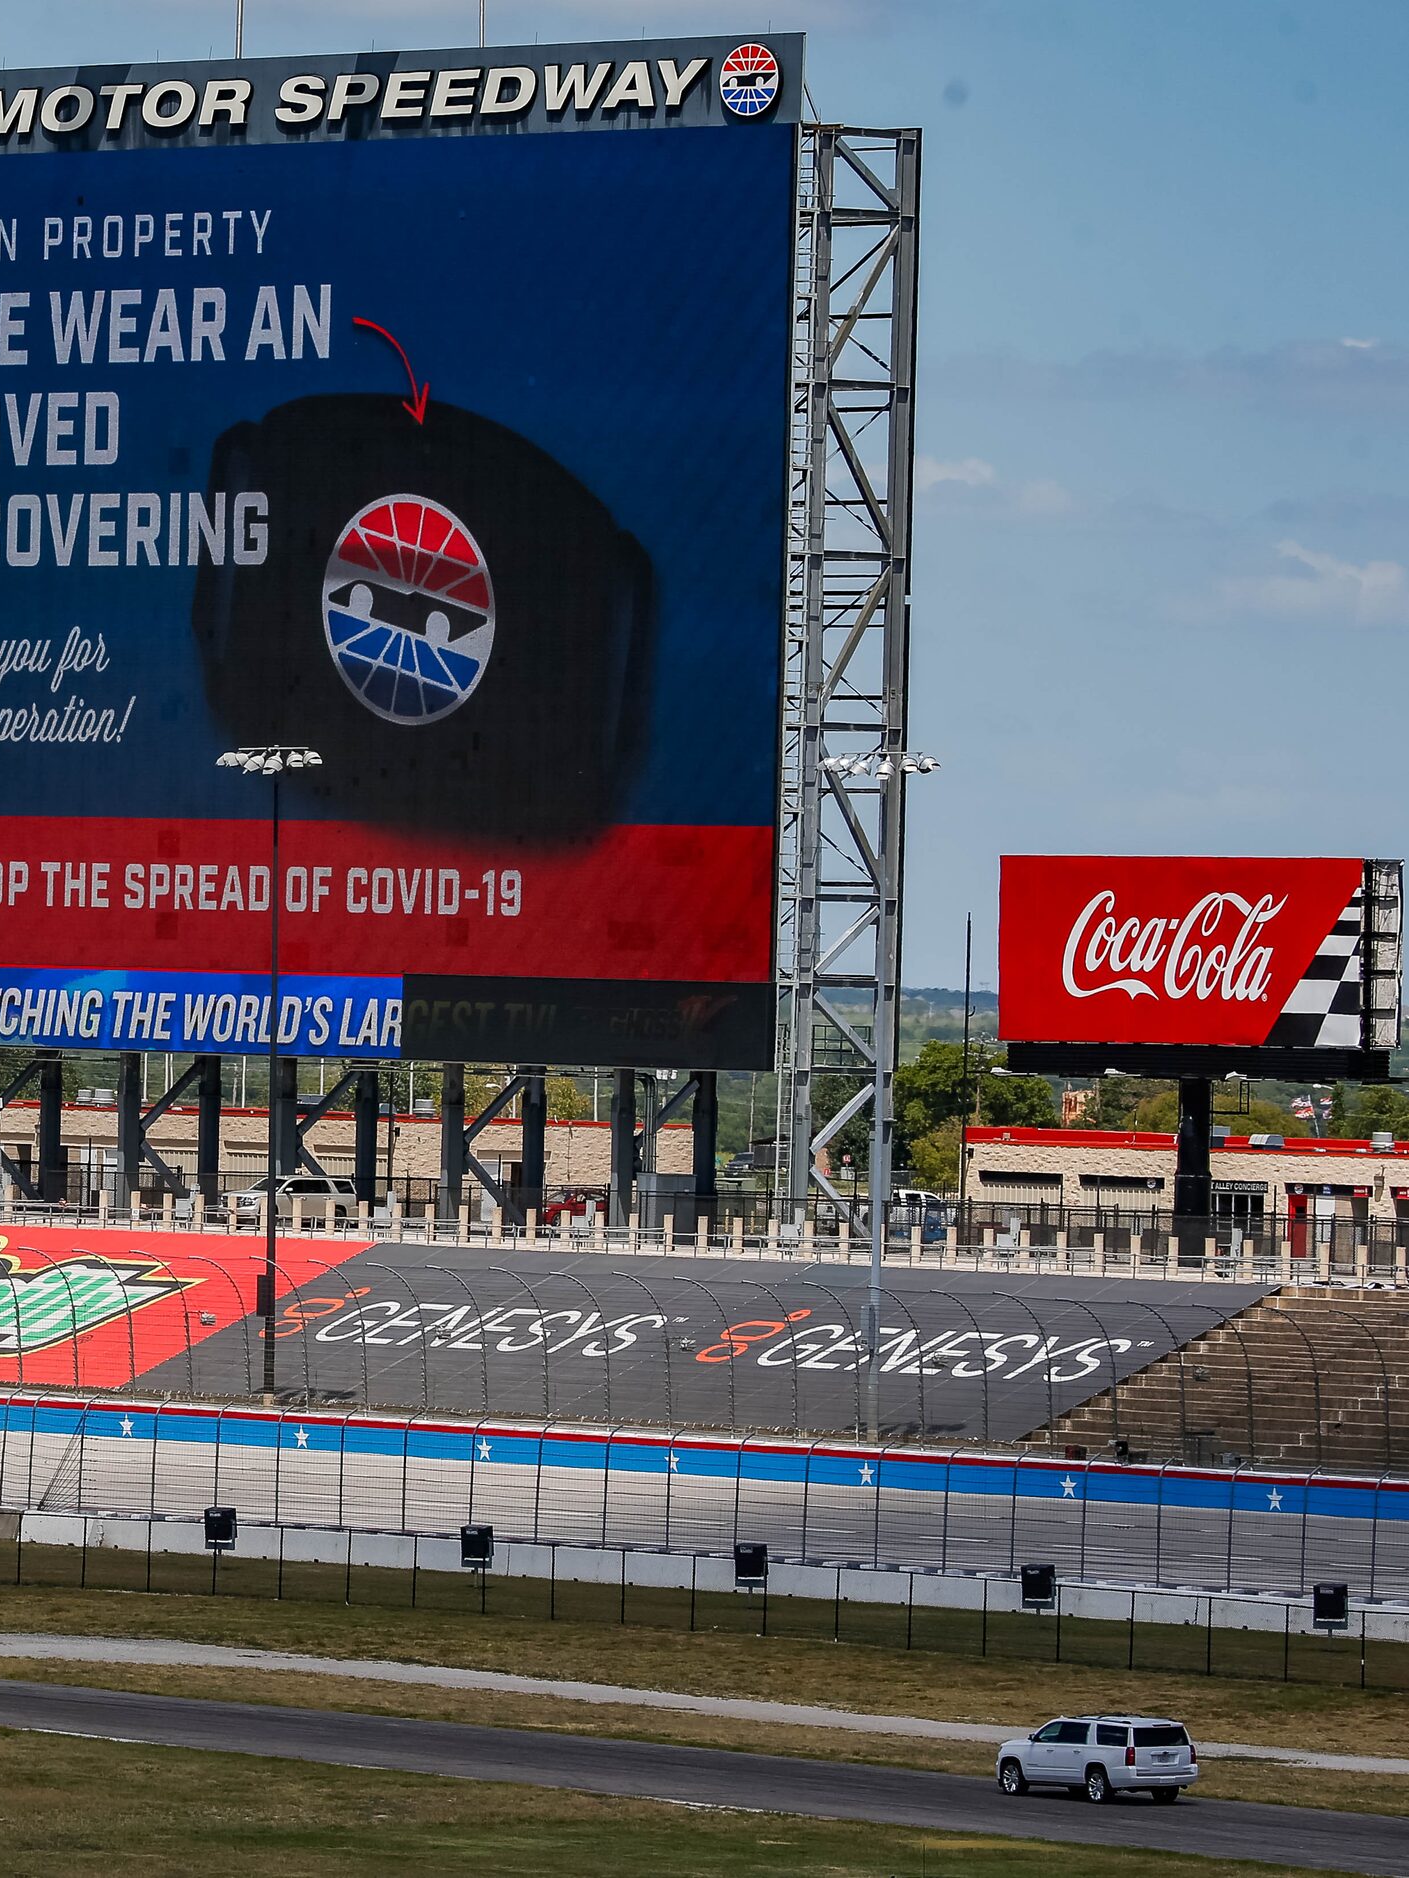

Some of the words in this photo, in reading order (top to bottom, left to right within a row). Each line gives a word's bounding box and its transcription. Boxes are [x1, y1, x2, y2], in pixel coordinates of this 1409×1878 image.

[274, 58, 708, 124] SPEEDWAY
[43, 210, 273, 260] PROPERTY
[49, 287, 228, 365] WEAR
[244, 284, 332, 361] AN
[50, 627, 110, 691] for
[41, 861, 109, 909] THE
[124, 864, 270, 912] SPREAD
[284, 867, 331, 913] OF
[347, 868, 522, 916] COVID-19
[1062, 890, 1289, 1001] Coca-Cola
[110, 991, 172, 1040] THE
[183, 992, 333, 1046] WORLD'S
[1214, 1181, 1233, 1190] ALLEY
[1234, 1183, 1268, 1191] CONCIERGE
[315, 1300, 668, 1356] GENESYS
[756, 1324, 1133, 1383] GENESYS
